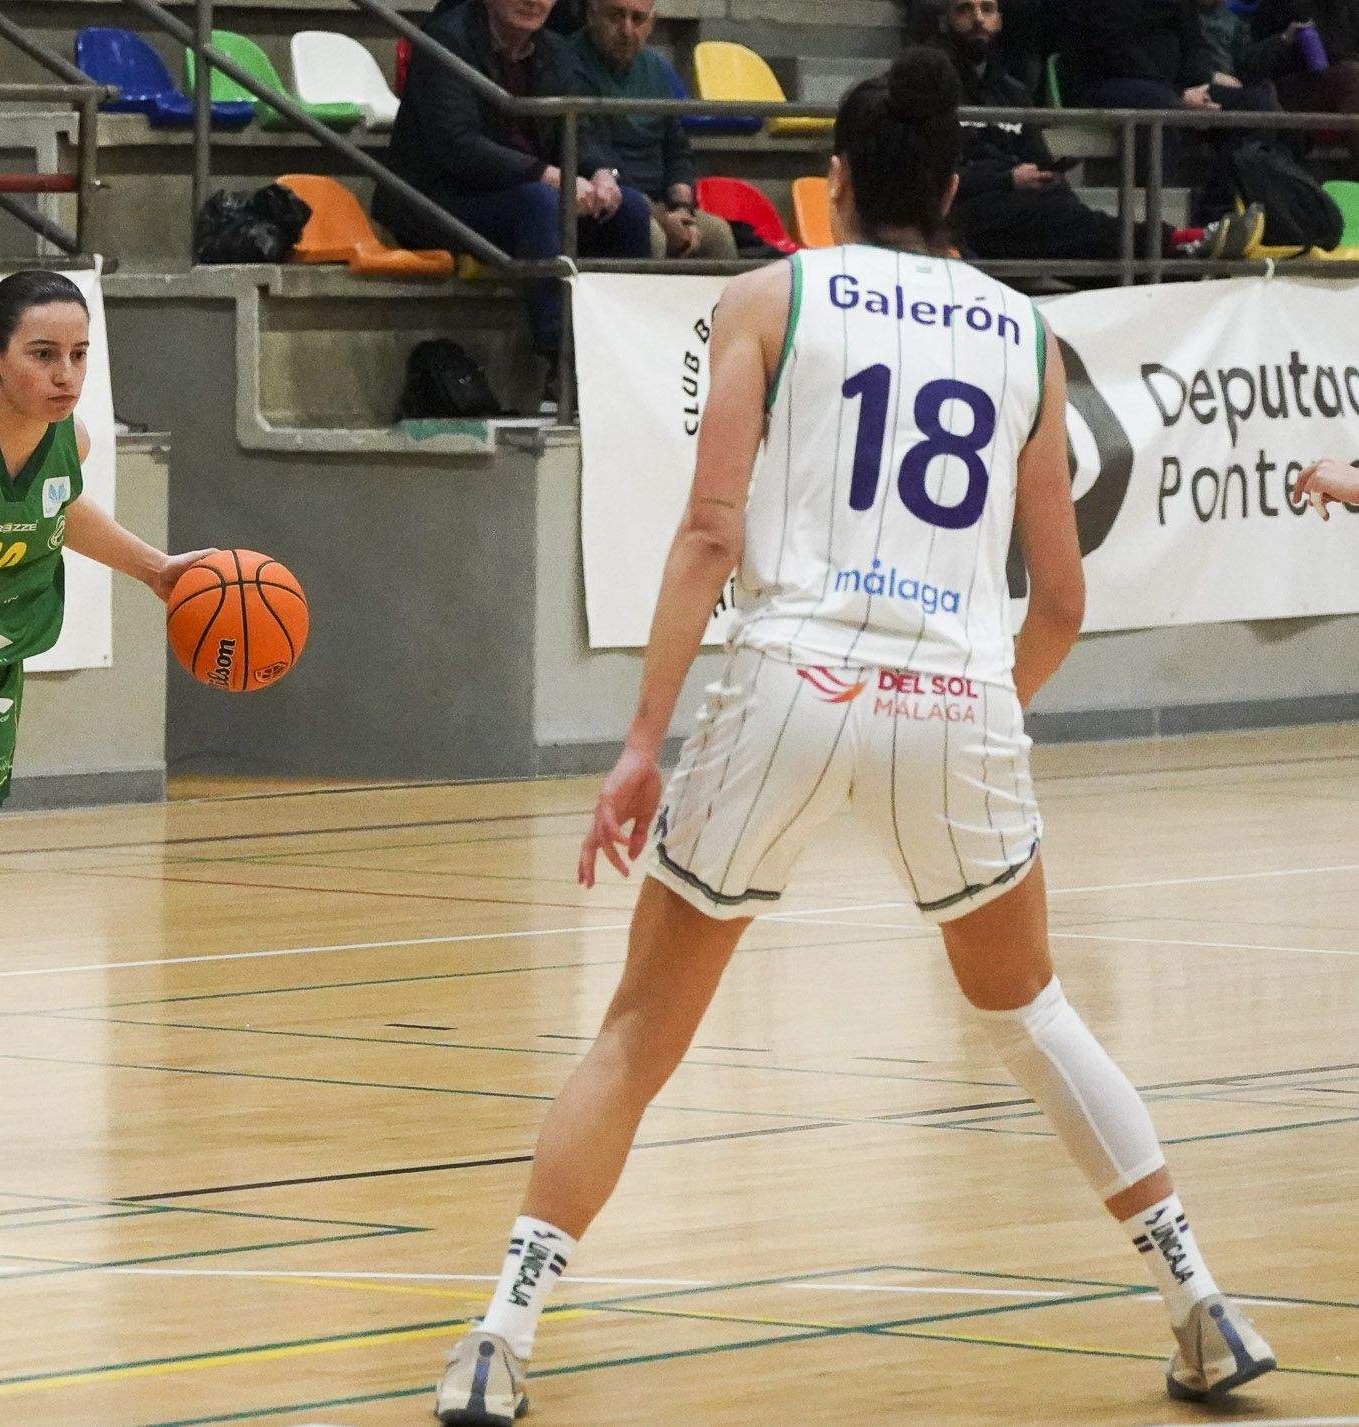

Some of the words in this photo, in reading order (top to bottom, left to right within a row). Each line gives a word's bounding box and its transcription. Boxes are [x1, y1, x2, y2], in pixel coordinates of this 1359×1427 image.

[828, 273, 1021, 346] Galerón
[682, 351, 701, 437] CLUB
[842, 363, 997, 530] 18
[877, 668, 926, 695] DEL
[931, 675, 979, 699] SOL
[508, 1240, 552, 1309] UNICAJA
